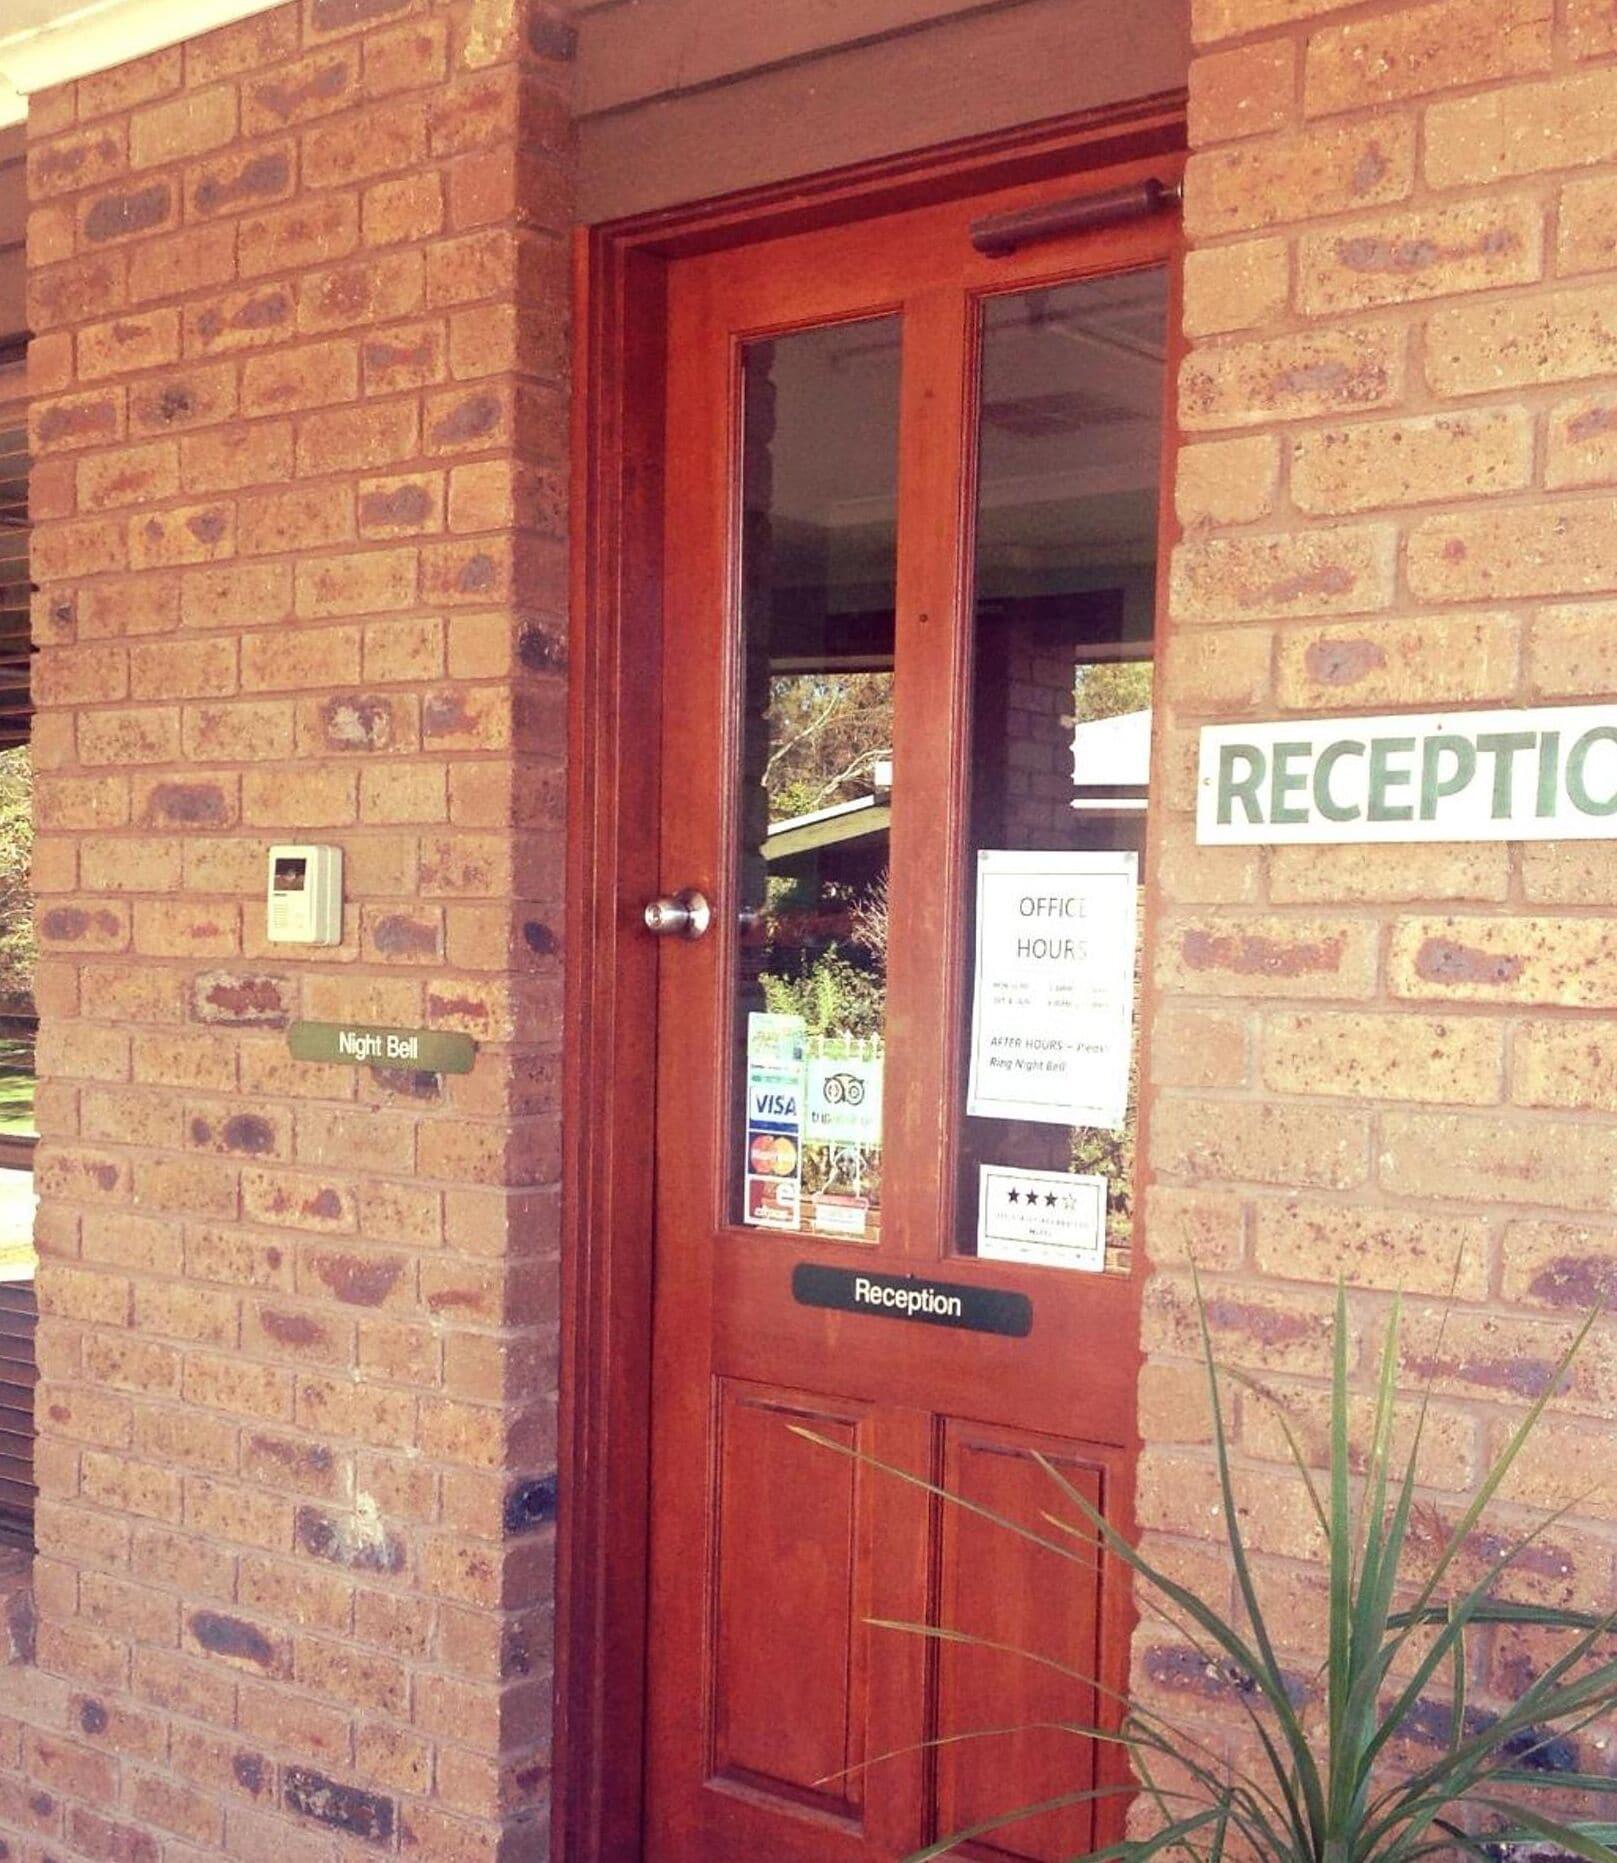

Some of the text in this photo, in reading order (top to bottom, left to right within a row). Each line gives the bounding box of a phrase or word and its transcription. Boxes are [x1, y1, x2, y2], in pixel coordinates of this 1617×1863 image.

[1019, 896, 1088, 918] OFFICE
[339, 1031, 418, 1061] Night Bell
[990, 1035, 1022, 1049] AFTER
[1025, 1039, 1063, 1051] HOURS
[989, 1056, 1013, 1071] Ring
[1015, 1058, 1044, 1072] Night
[756, 1094, 797, 1116] VISA
[855, 1278, 961, 1317] Reception
